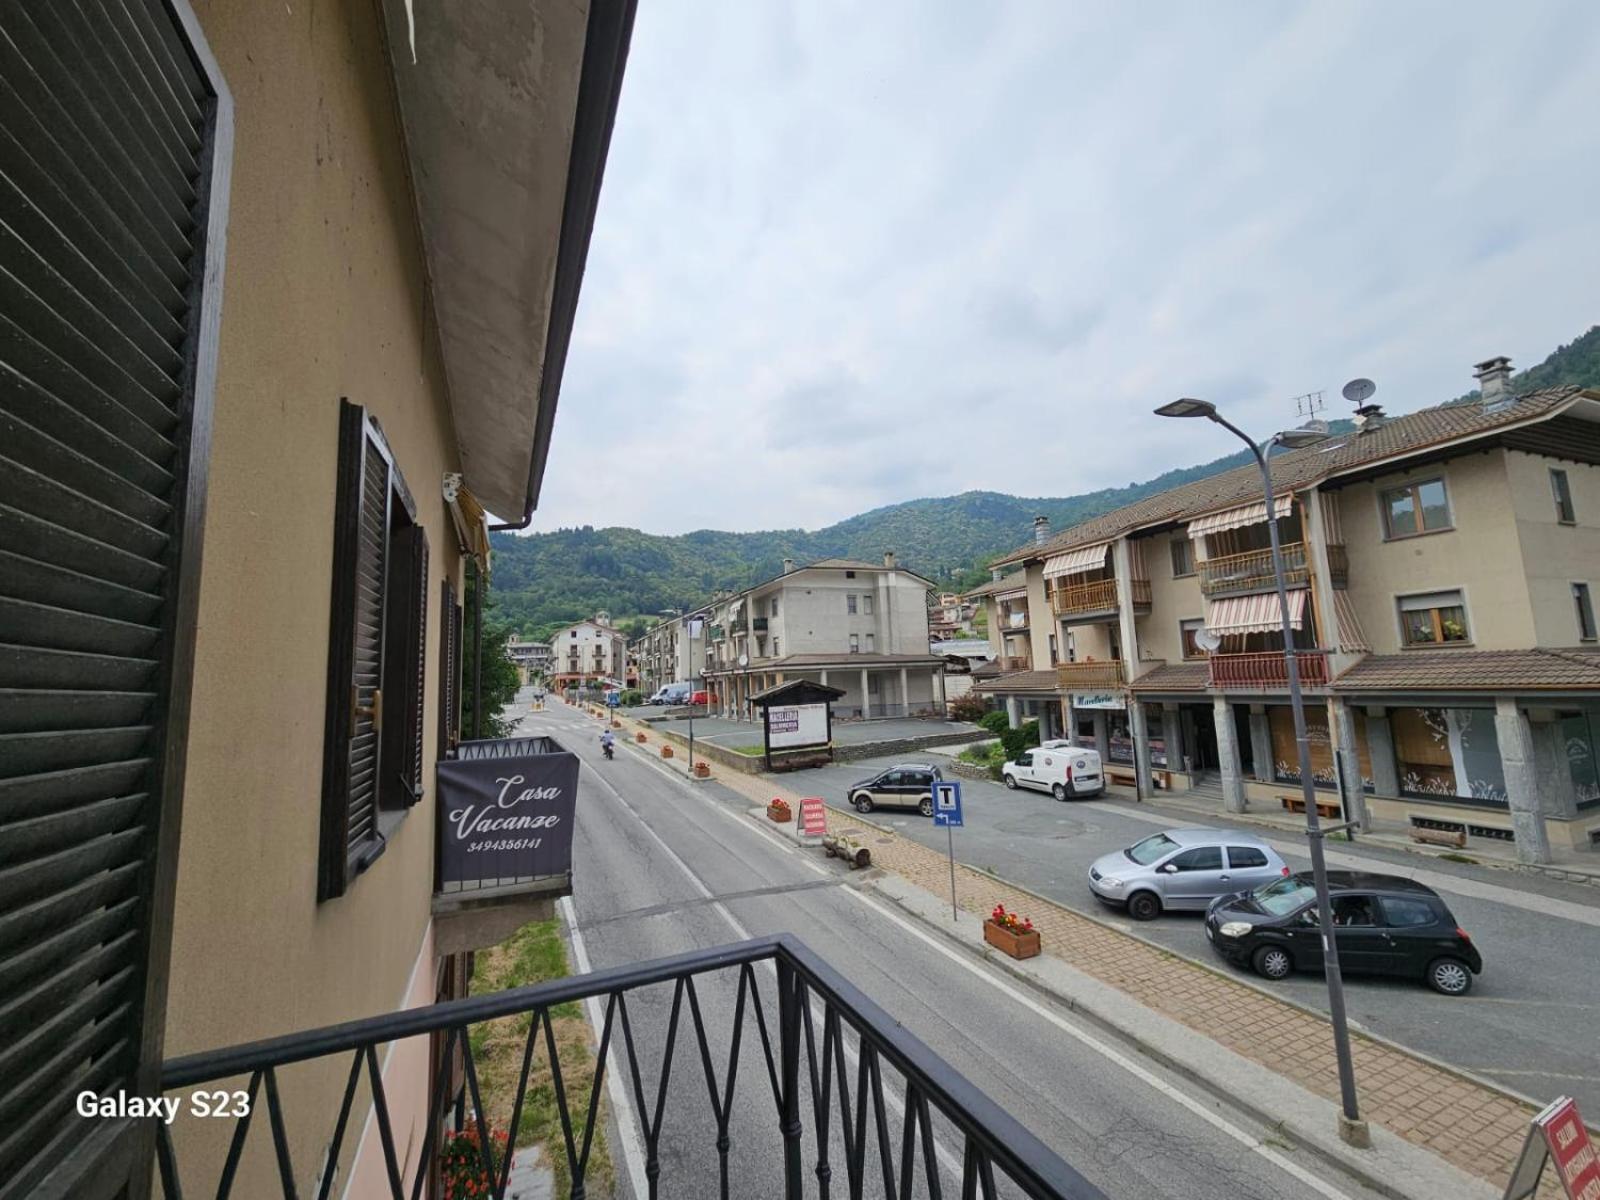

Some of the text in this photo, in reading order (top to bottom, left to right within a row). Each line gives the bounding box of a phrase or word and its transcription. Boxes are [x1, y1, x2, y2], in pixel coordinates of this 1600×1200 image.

[496, 774, 561, 808] Casa
[939, 788, 952, 804] T
[449, 805, 561, 840] Vacanze
[467, 838, 542, 853] 3494356141
